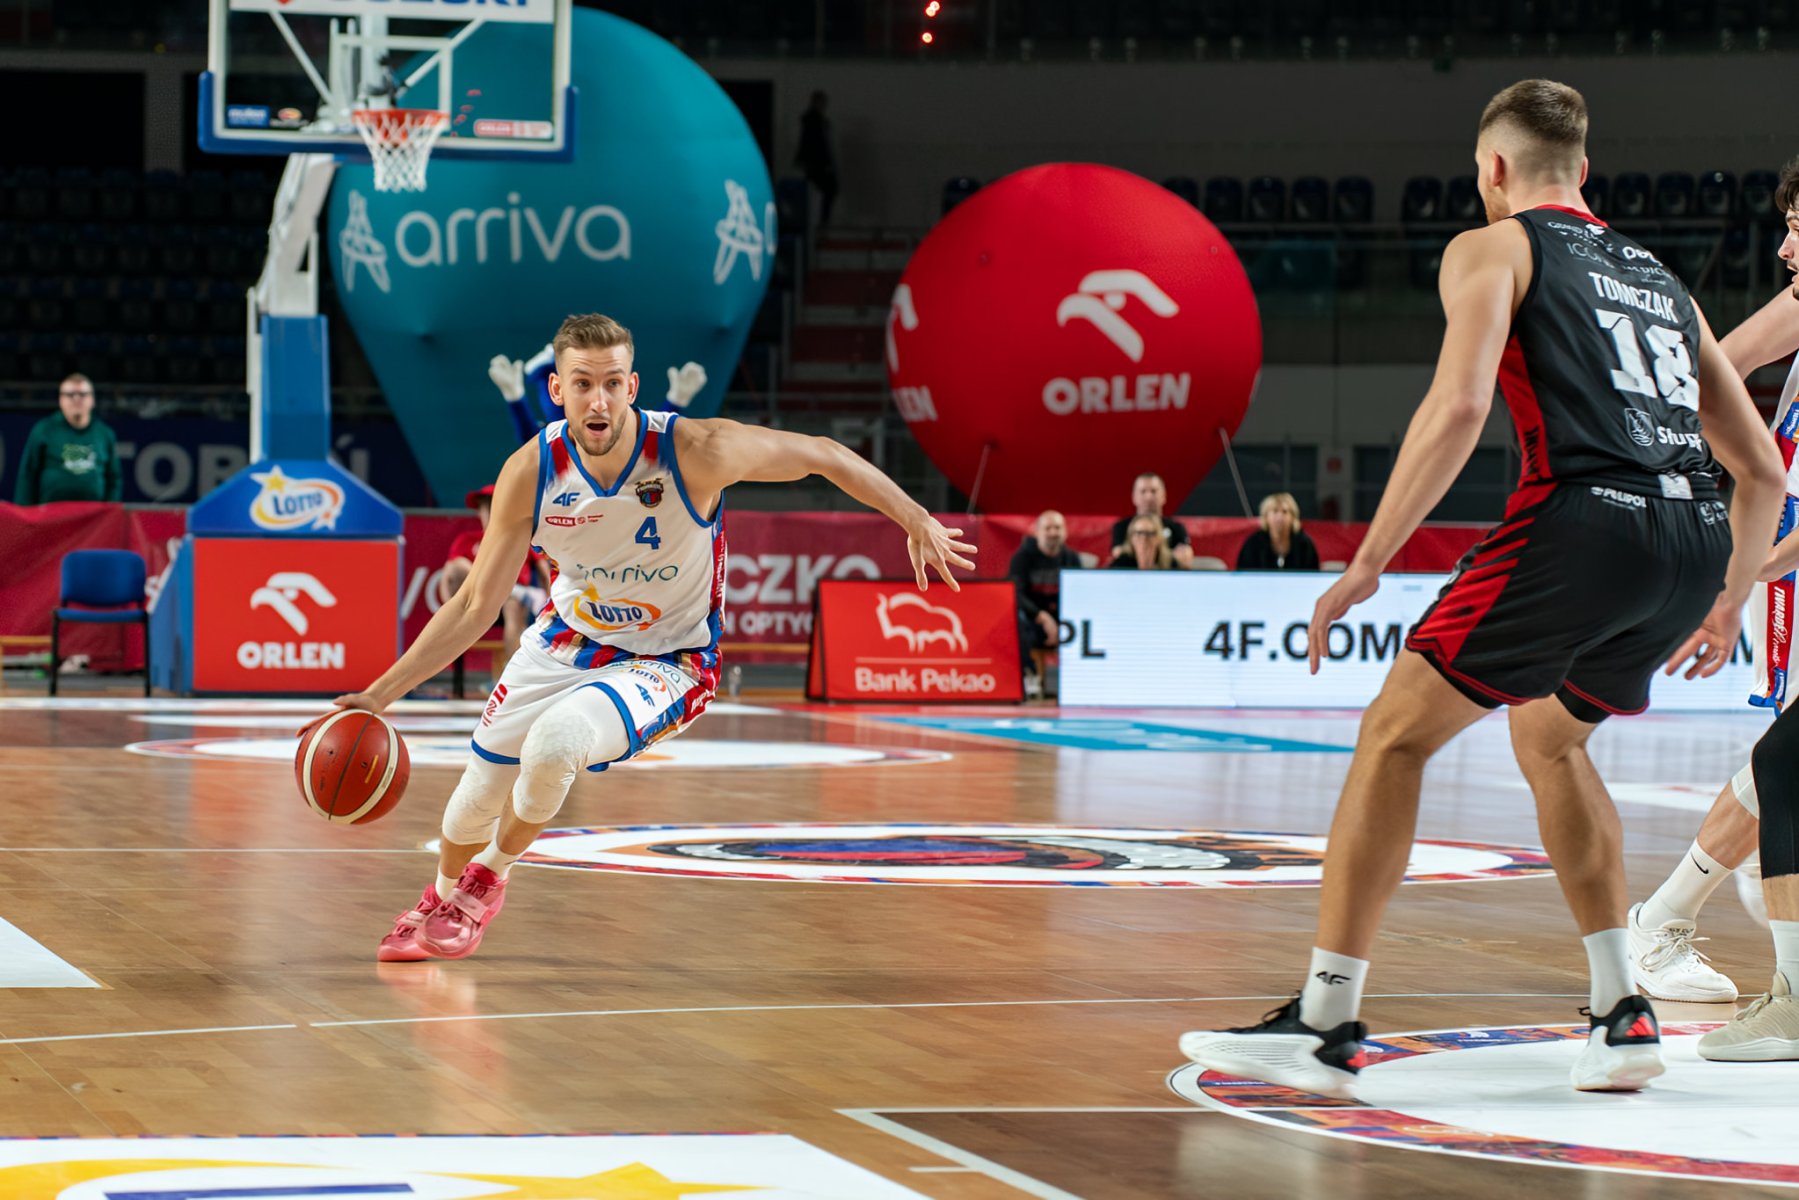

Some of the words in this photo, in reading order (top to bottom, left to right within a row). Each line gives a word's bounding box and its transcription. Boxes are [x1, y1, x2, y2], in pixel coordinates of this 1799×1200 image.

[394, 192, 631, 268] arriva
[1588, 271, 1678, 323] TOMCZAK
[1595, 309, 1699, 412] 18
[1042, 373, 1191, 415] ORLEN
[552, 492, 580, 507] 4F
[635, 516, 661, 550] 4
[586, 601, 643, 623] LOTTO
[237, 642, 345, 669] ORLEN
[1203, 620, 1402, 662] 4F.COM
[855, 667, 917, 692] Bank
[922, 667, 996, 692] Pekao
